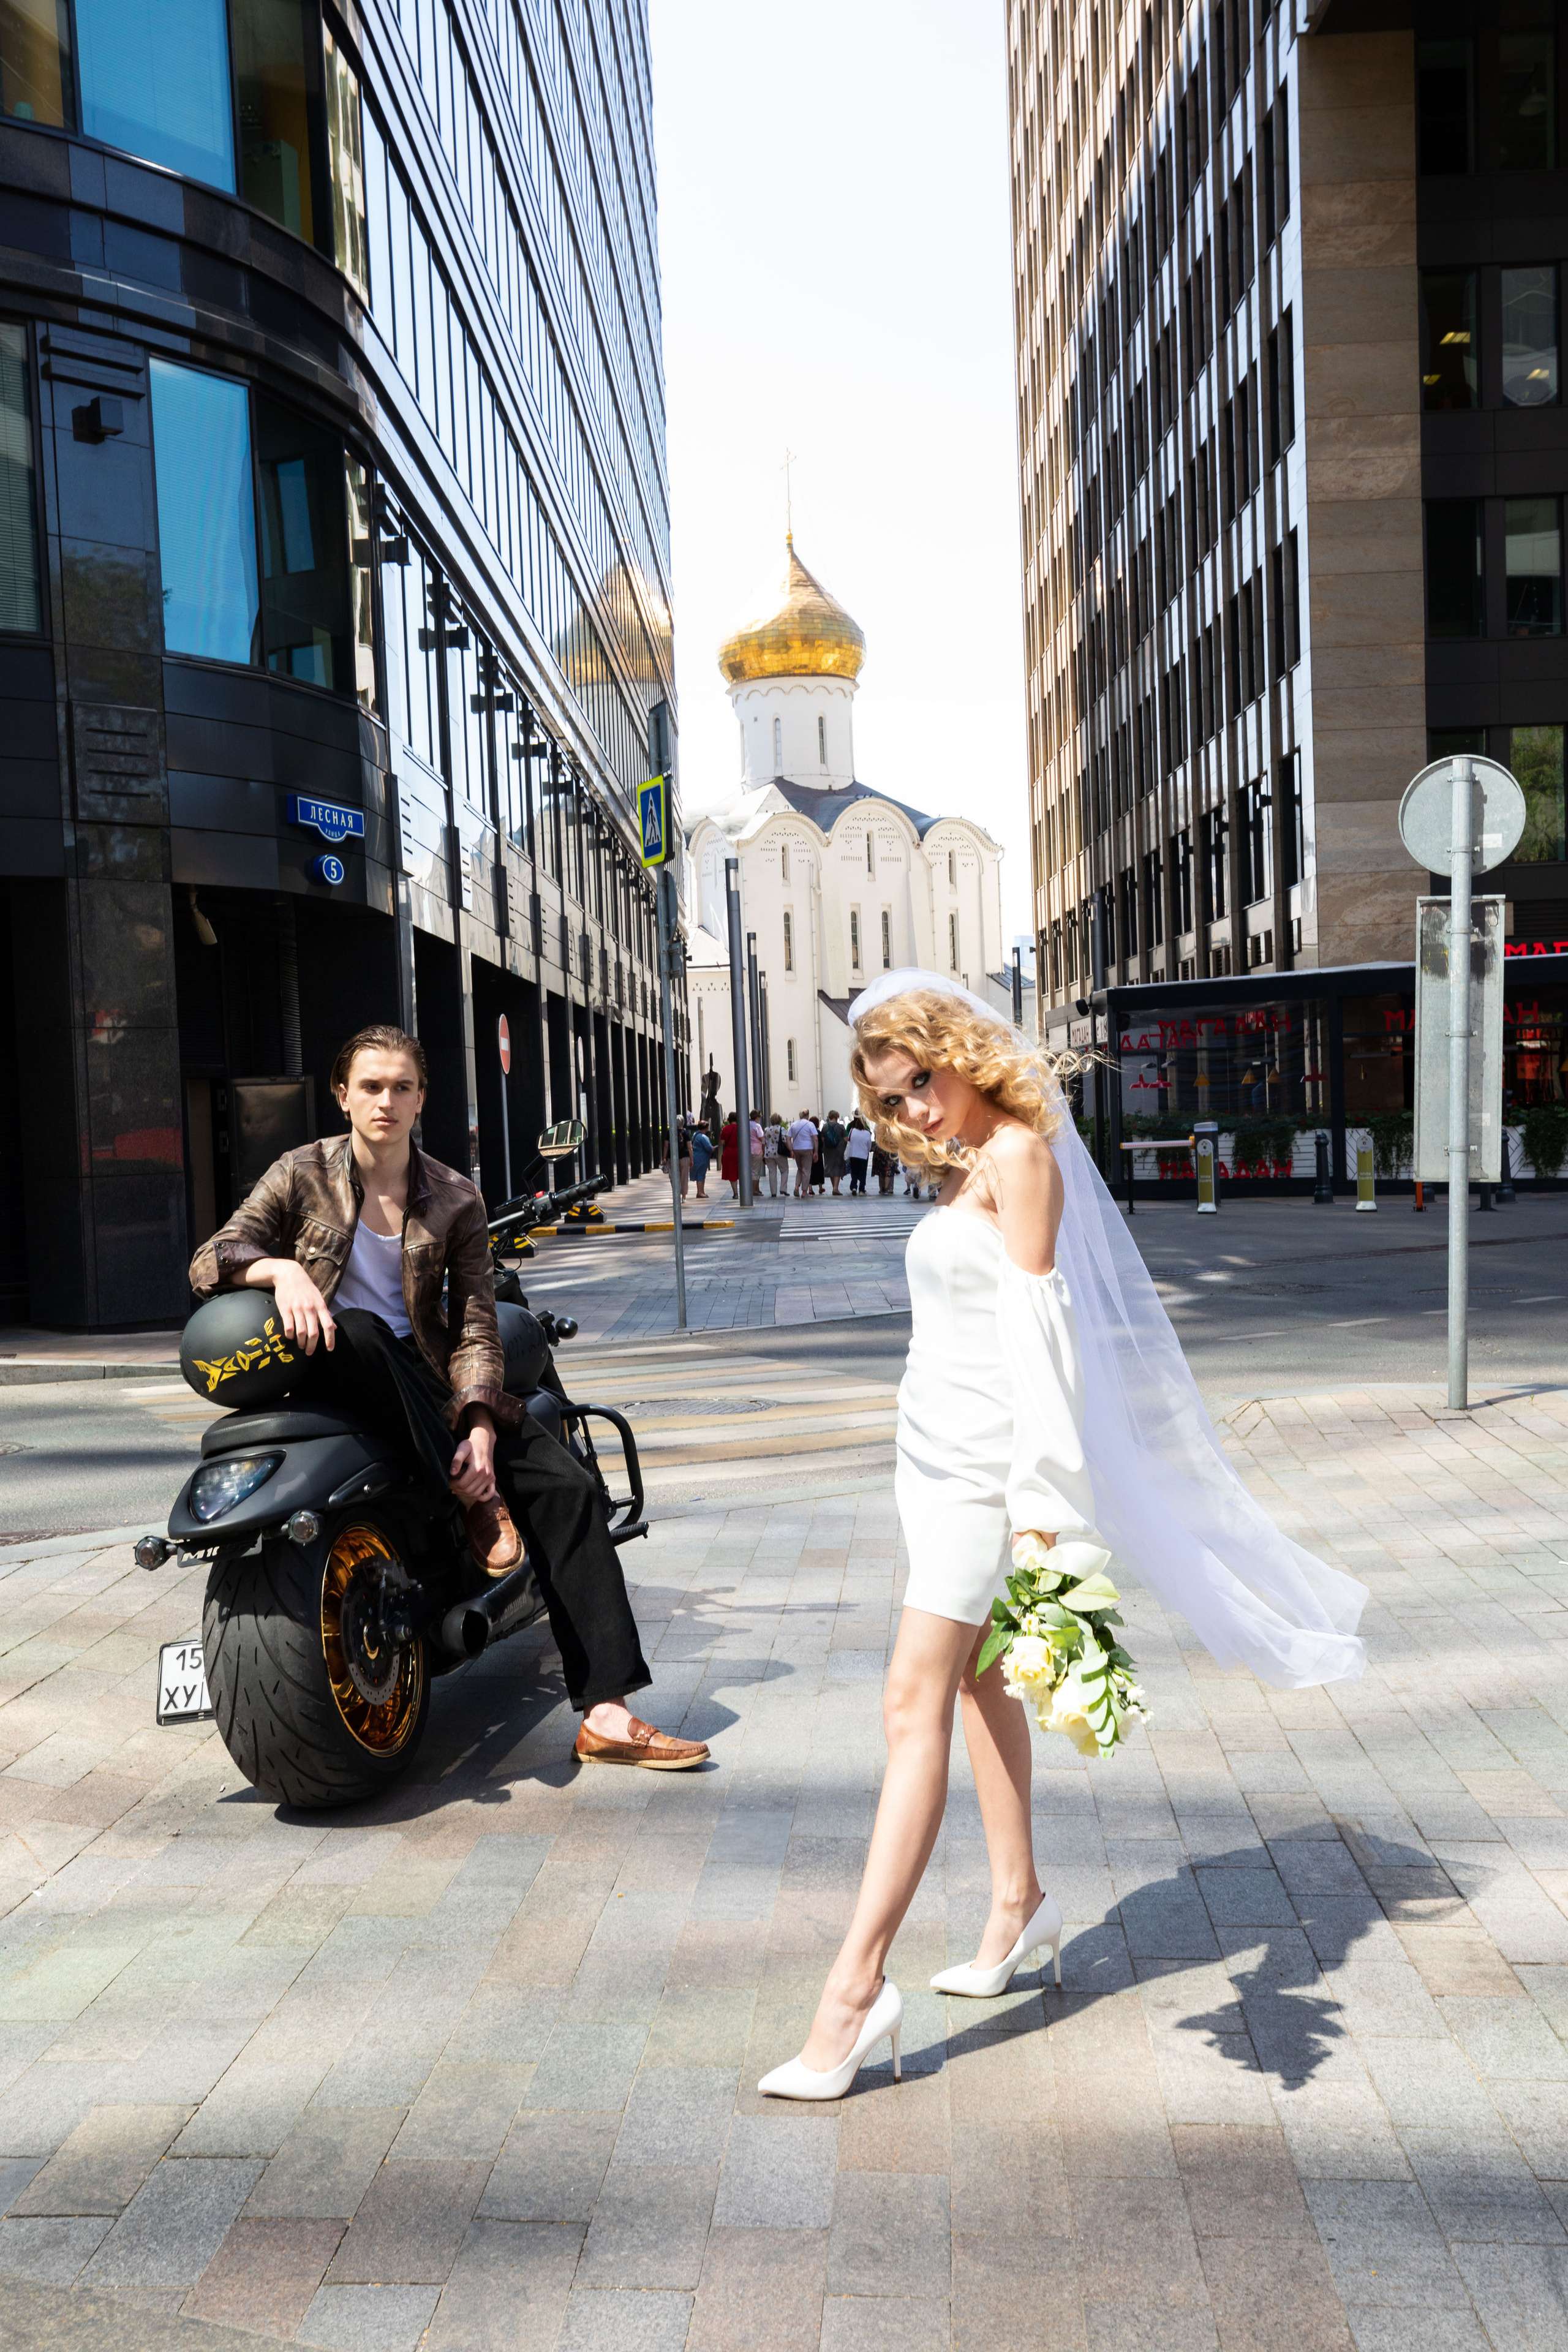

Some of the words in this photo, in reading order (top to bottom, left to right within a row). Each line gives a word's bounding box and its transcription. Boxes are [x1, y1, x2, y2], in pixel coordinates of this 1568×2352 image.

[311, 805, 353, 828] ЛЕСНАЯ
[331, 861, 337, 879] 5
[1157, 1013, 1291, 1037] МАГАДАН
[1159, 1159, 1292, 1179] МААДАН
